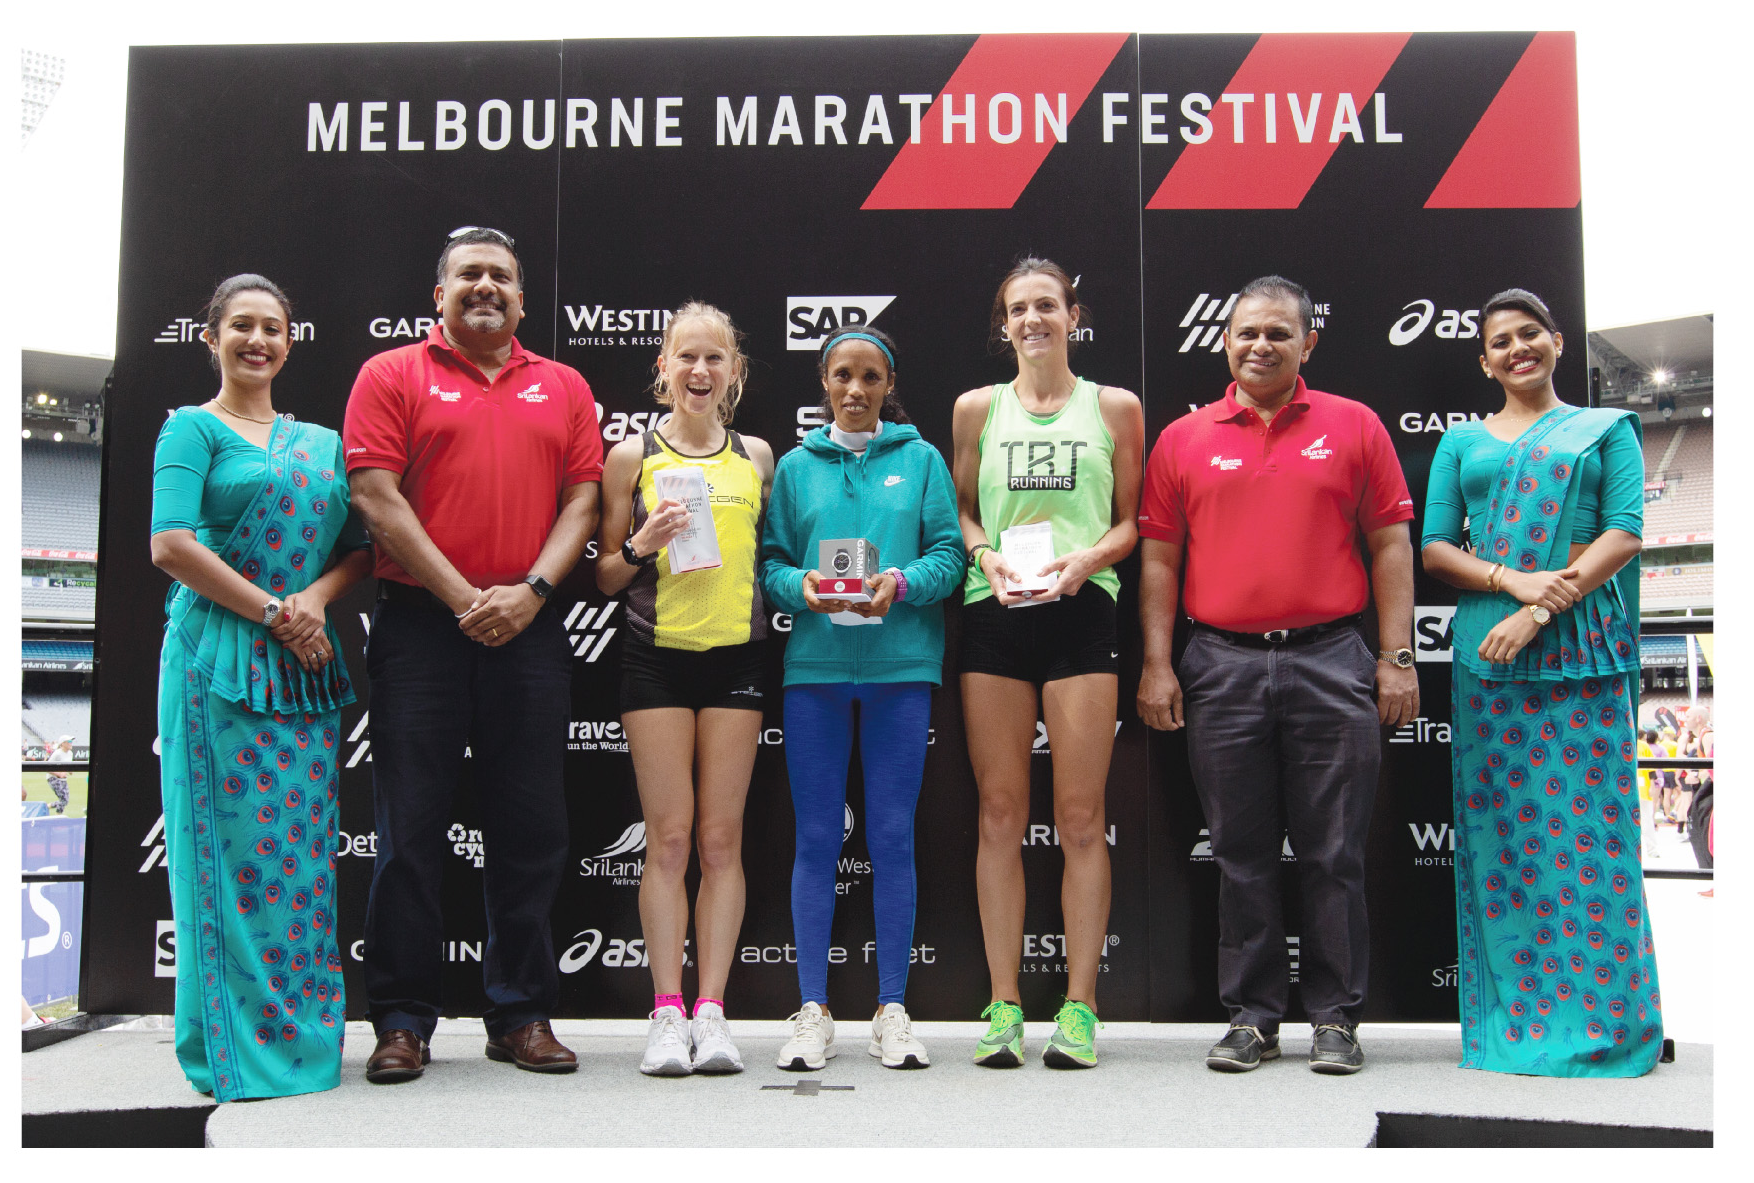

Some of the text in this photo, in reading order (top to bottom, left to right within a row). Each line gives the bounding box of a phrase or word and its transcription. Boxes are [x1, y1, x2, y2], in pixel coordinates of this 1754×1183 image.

[307, 92, 1403, 152] MELBOURNE MARATHON FESTIVAL
[789, 306, 868, 340] SAP
[568, 337, 615, 346] HOTELS
[619, 337, 627, 346] &
[1011, 477, 1072, 489] RUNNING
[856, 539, 864, 579] GARMIN
[582, 742, 597, 750] the
[612, 878, 641, 886] Airlines
